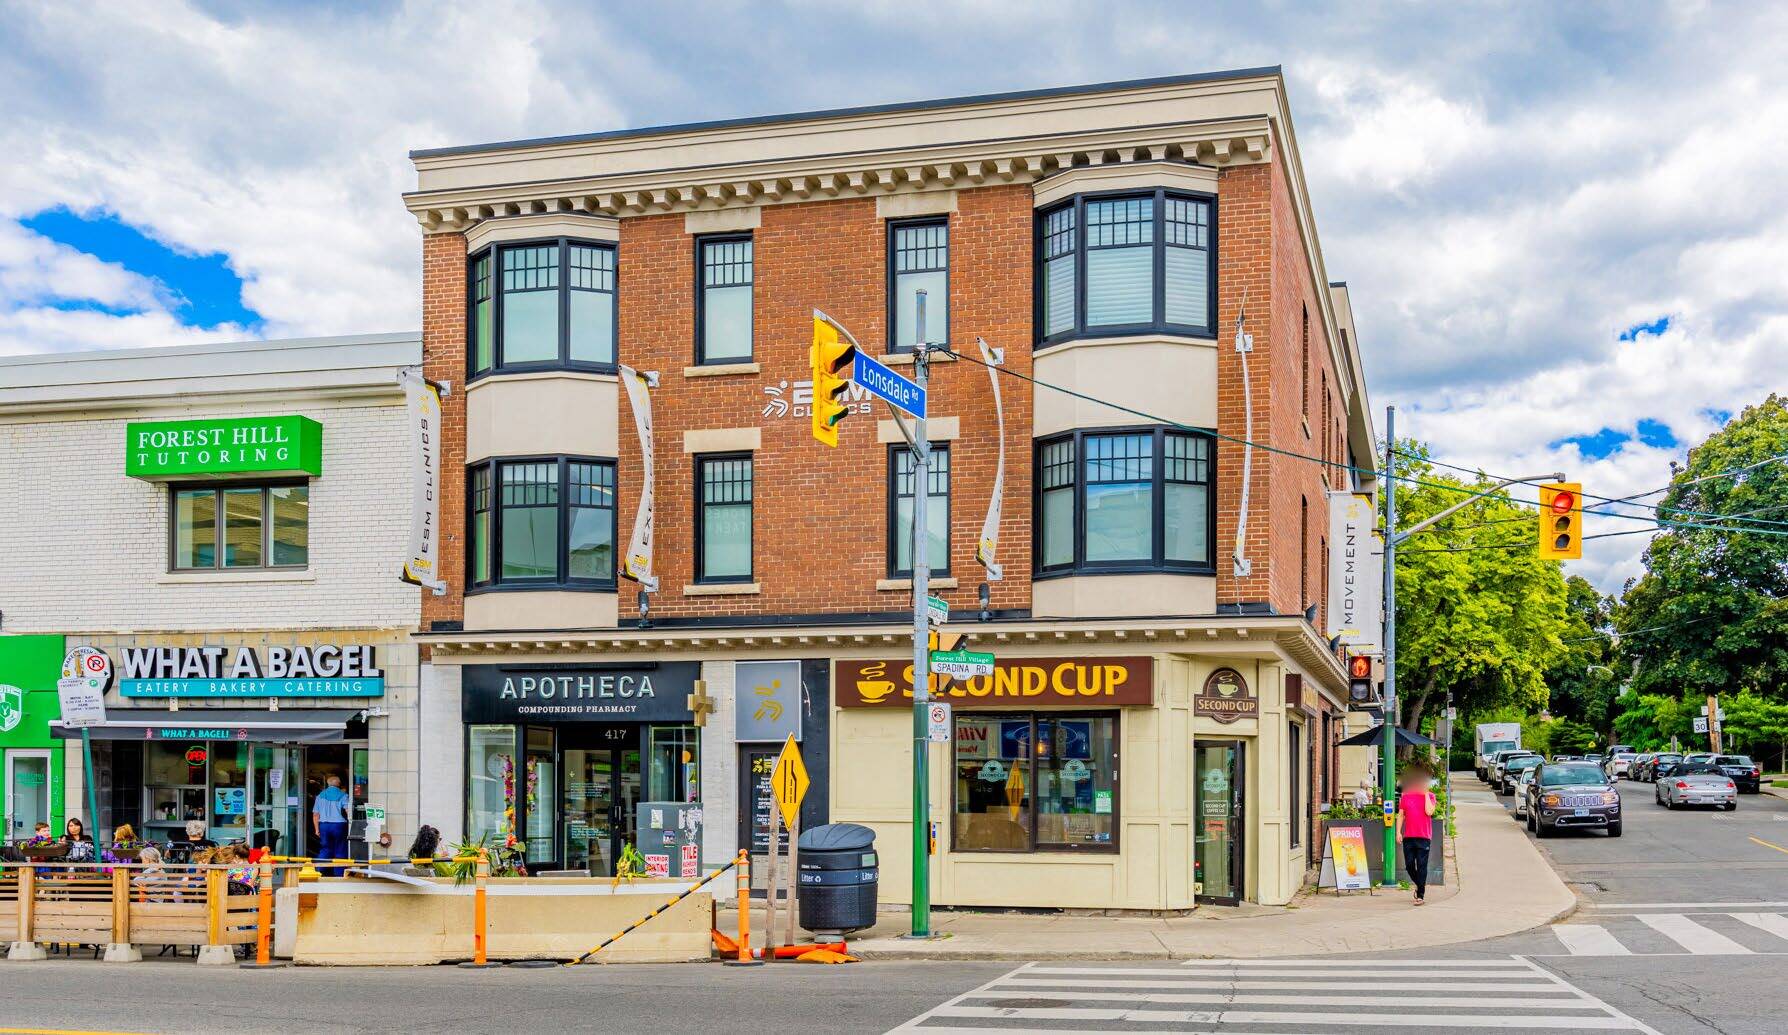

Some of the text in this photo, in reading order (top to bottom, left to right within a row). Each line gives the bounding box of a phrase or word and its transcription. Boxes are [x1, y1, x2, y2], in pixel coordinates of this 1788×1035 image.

[862, 360, 919, 405] Lonsdale Rd
[793, 379, 872, 404] EM
[138, 426, 289, 449] FOREST HILL
[137, 447, 289, 466] TUTORING
[421, 418, 433, 502] CLINICS
[1344, 523, 1356, 625] MOVEMENT
[120, 644, 380, 678] WHAT A BAGEL
[936, 663, 987, 674] SPADINA RD
[1051, 662, 1129, 697] CUP
[136, 681, 364, 693] EATERY BAKERY CATERING
[499, 675, 656, 700] APOTHECA
[518, 705, 637, 714] COMPOUNDING PHARMACY
[1198, 698, 1256, 712] SECOND CUP
[161, 729, 229, 739] WHAT A BAGEL!
[1695, 723, 1706, 731] 30
[604, 729, 627, 740] 417
[1333, 830, 1361, 838] SPRING
[683, 846, 697, 860] TILE
[801, 873, 814, 882] Litter
[861, 871, 874, 881] Litter
